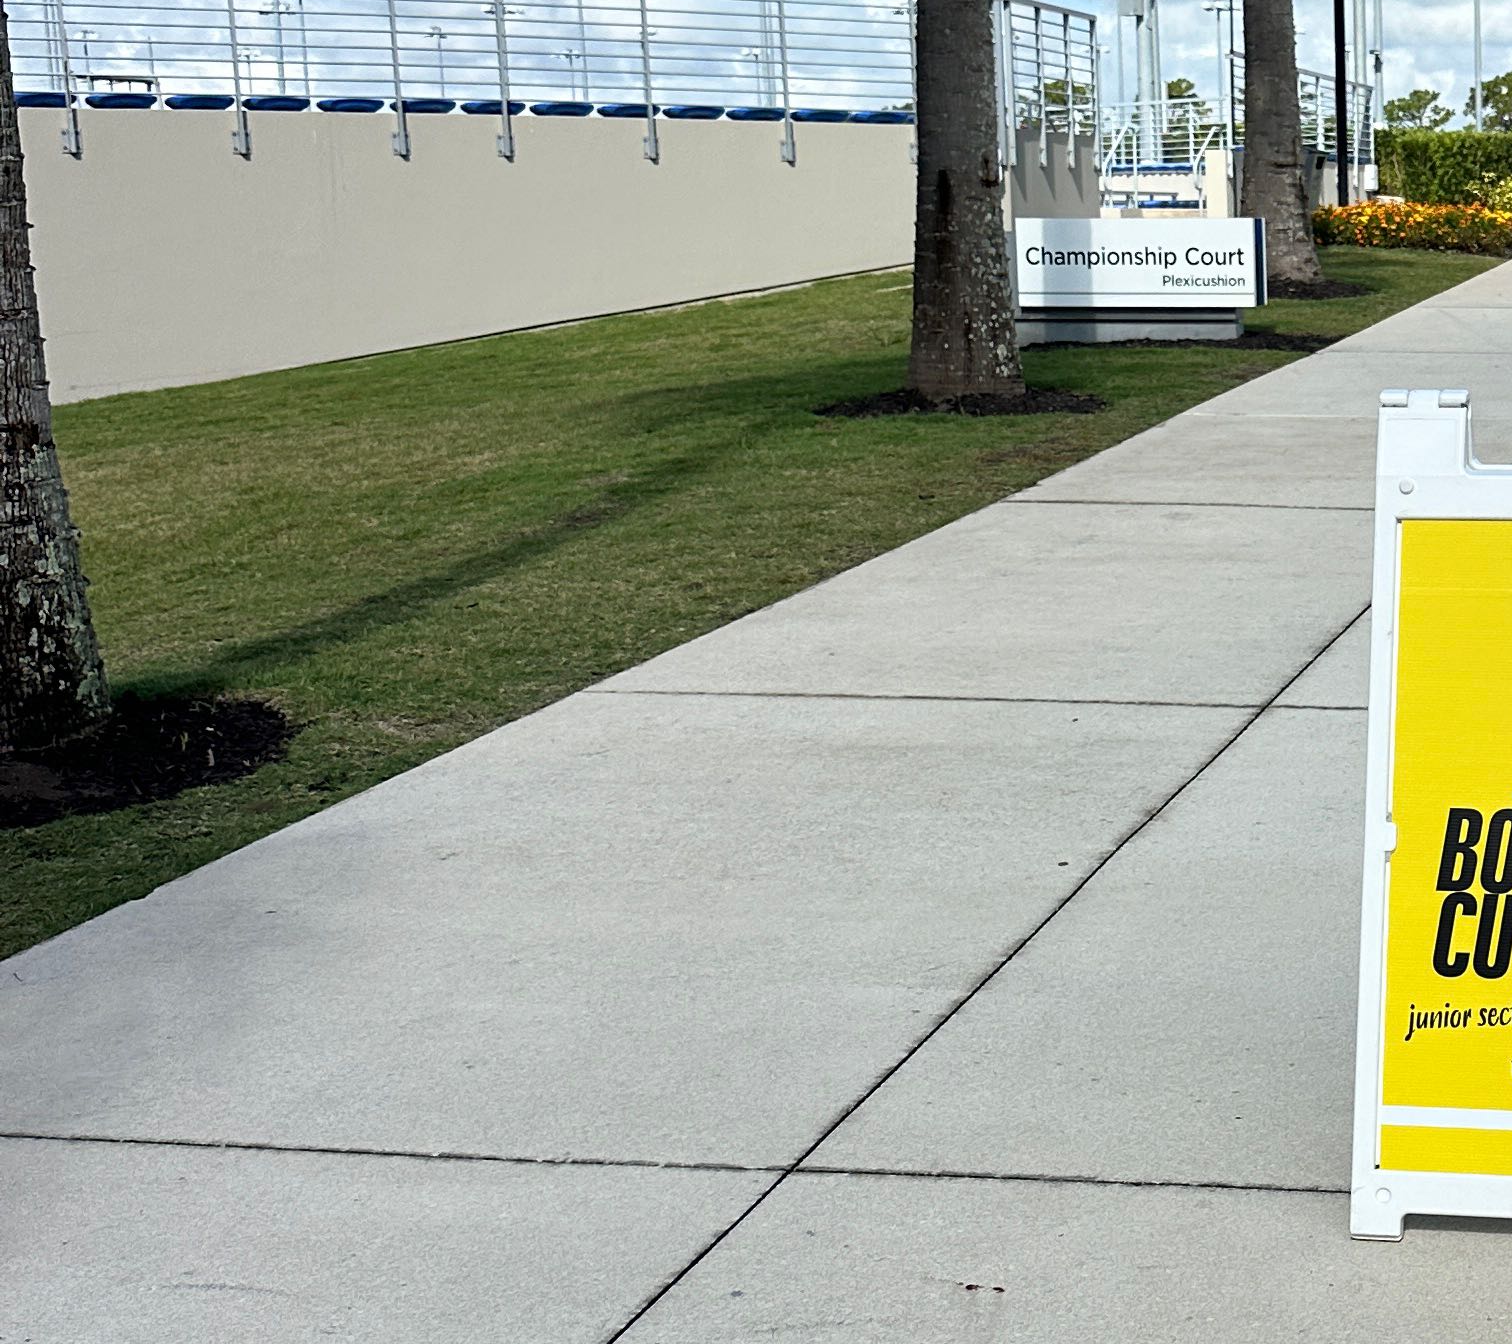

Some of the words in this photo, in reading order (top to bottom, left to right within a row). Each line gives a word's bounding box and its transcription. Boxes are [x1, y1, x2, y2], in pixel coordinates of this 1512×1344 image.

[1025, 246, 1177, 270] Championship
[1185, 247, 1245, 267] Court
[1162, 274, 1246, 288] Plexicushion
[1404, 1002, 1472, 1042] junior
